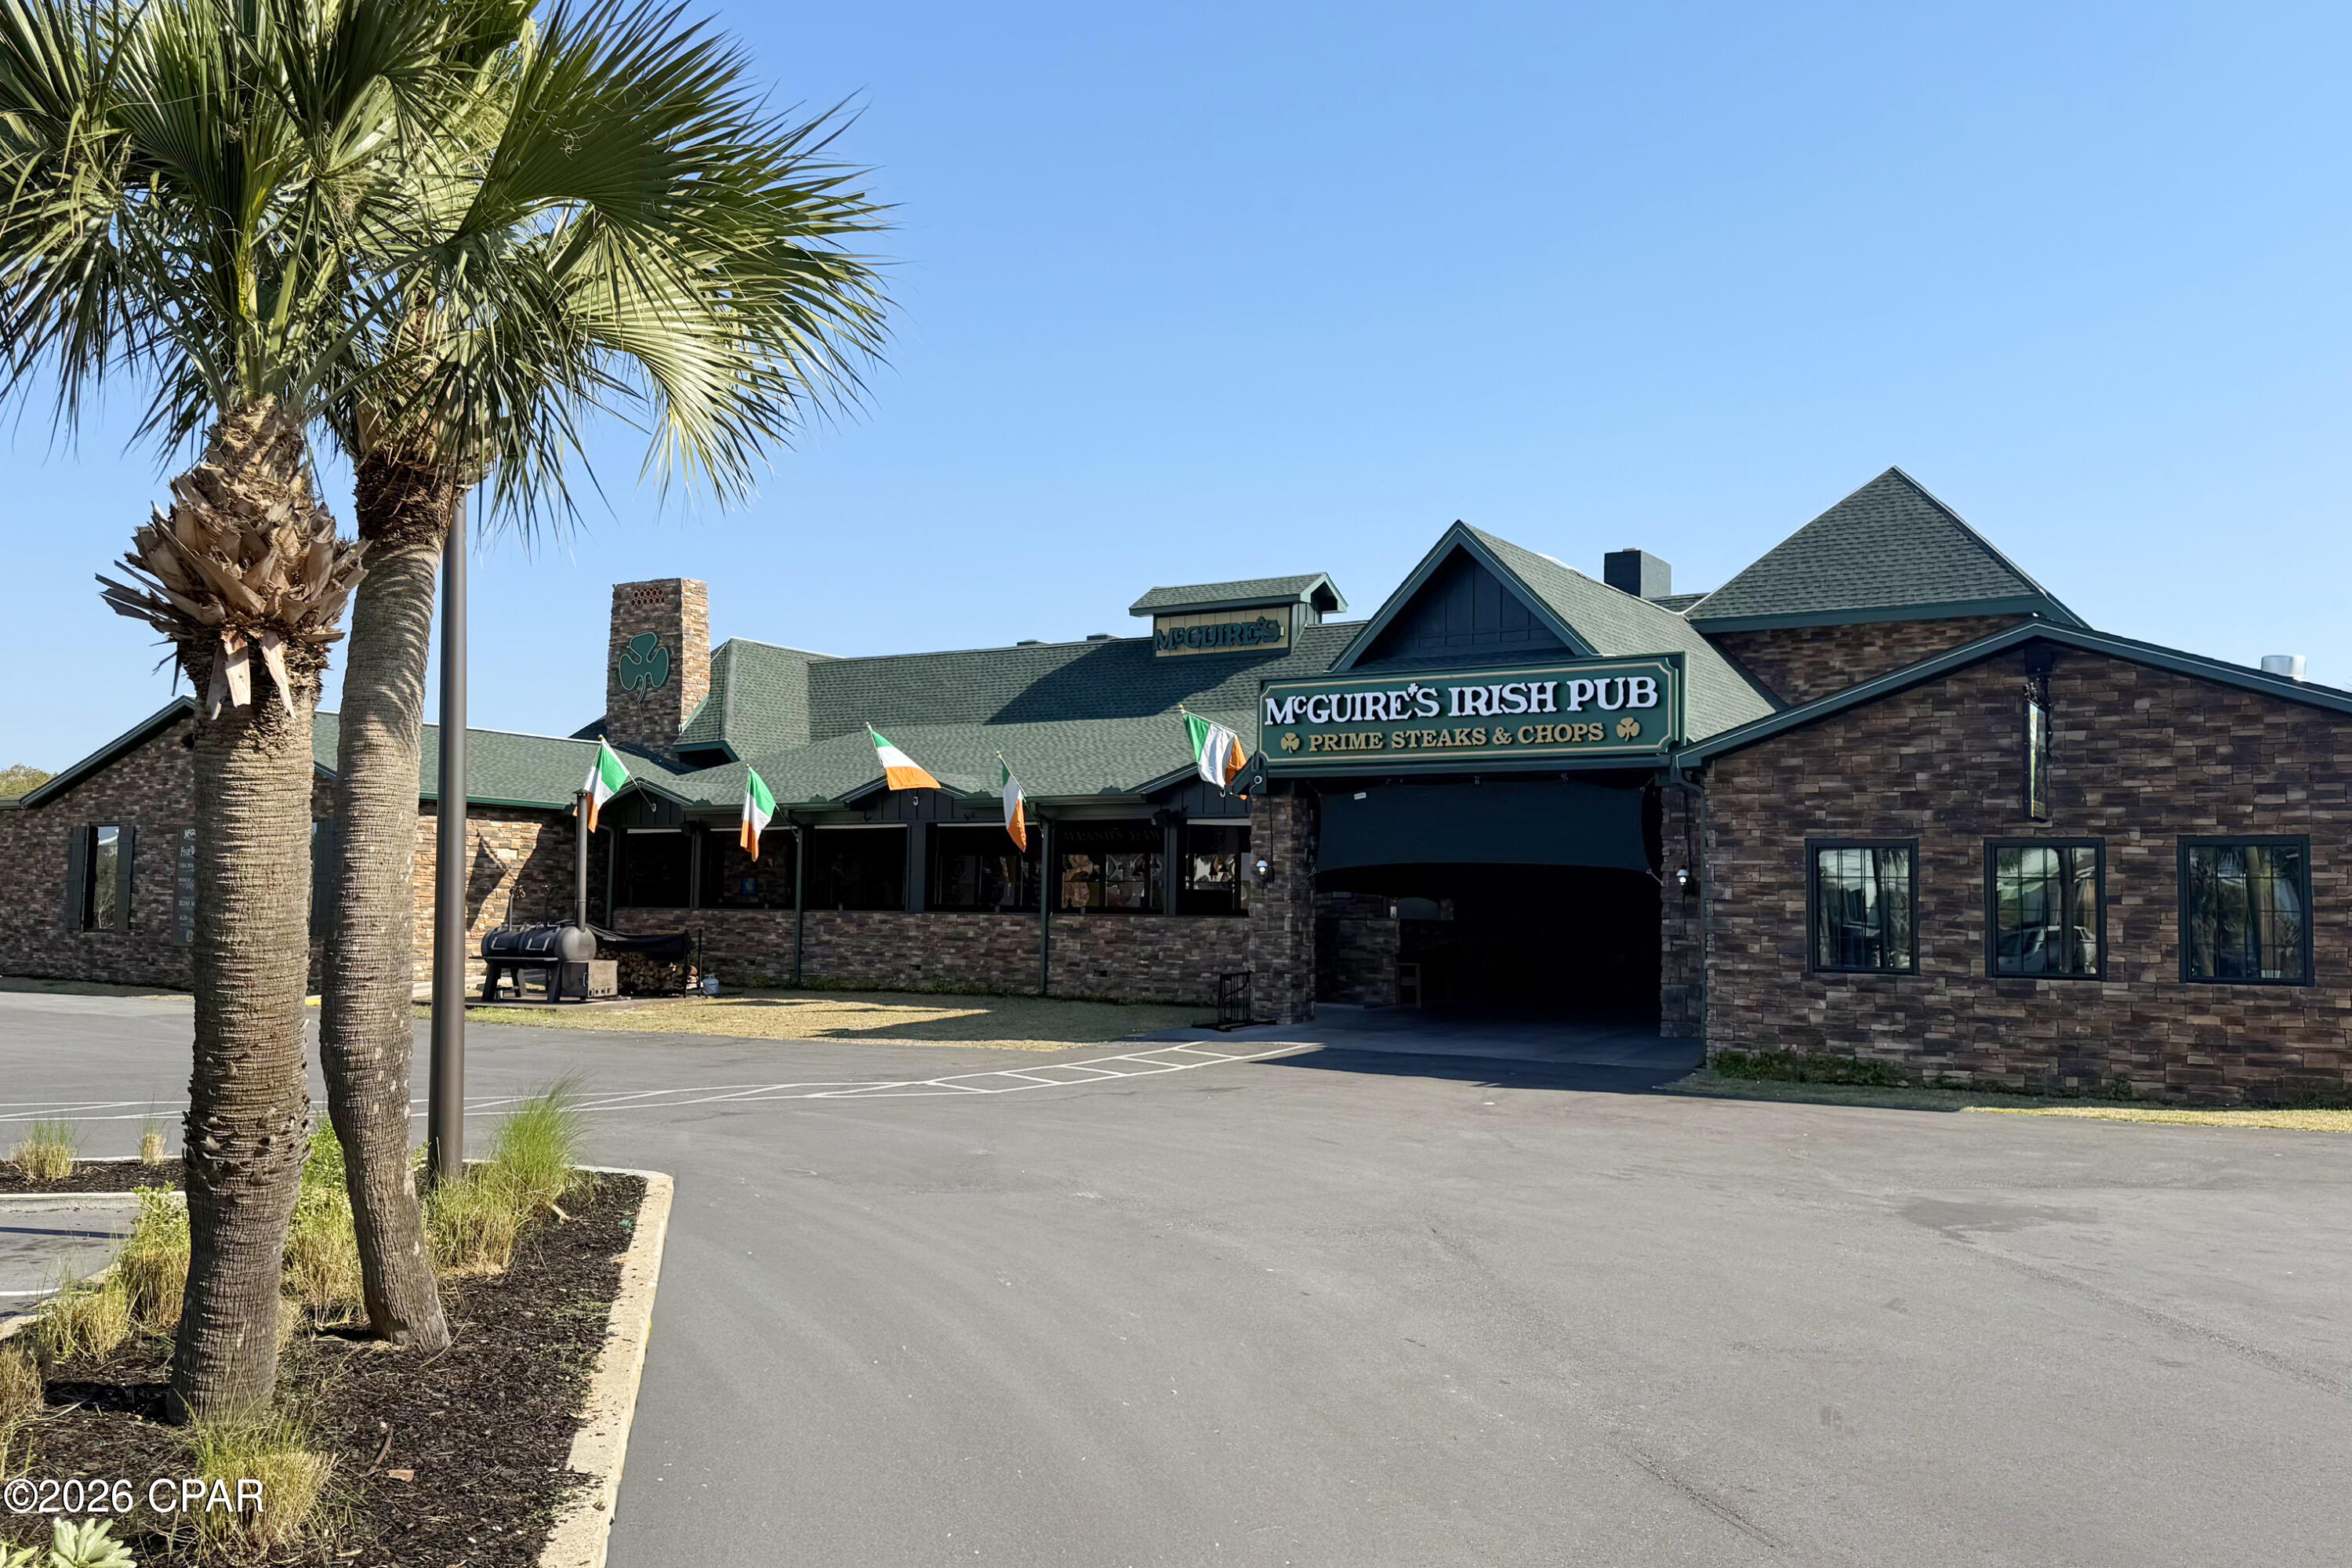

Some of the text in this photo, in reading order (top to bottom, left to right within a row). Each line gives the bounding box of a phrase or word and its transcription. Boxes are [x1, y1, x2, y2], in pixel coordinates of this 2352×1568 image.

[1448, 679, 1558, 717] IRISH
[1567, 677, 1658, 711] PUB
[1308, 722, 1605, 752] PRIME STEAKS & CHOPS
